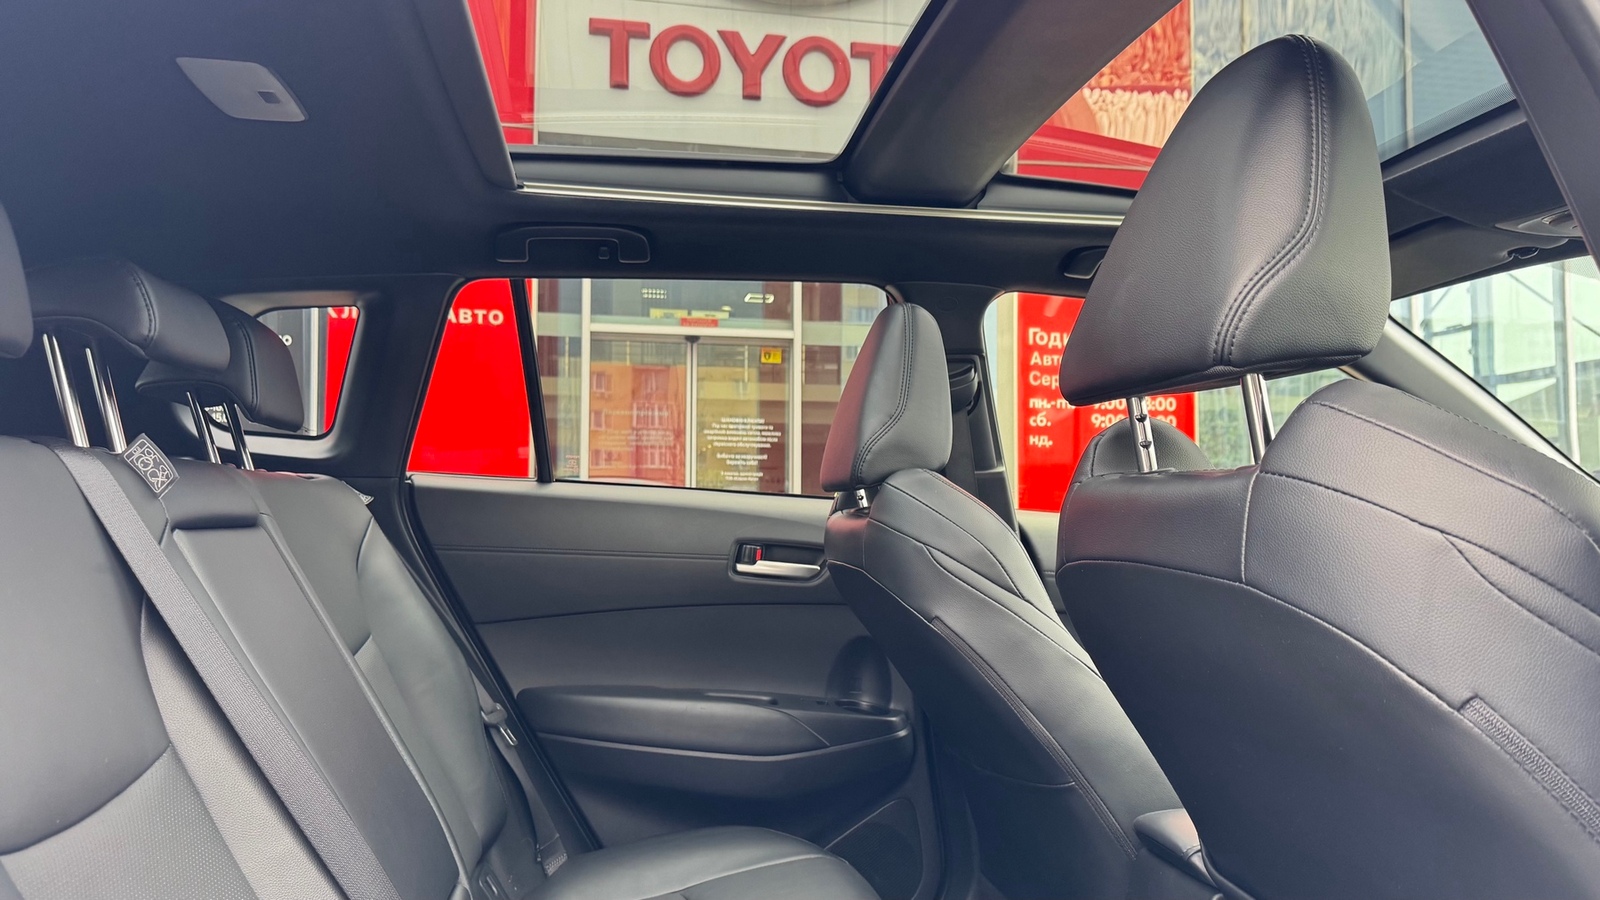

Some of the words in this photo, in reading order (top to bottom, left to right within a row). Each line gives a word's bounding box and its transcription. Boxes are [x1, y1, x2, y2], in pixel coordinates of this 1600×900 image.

[1029, 351, 1062, 366] Авт
[1029, 411, 1051, 427] сб.
[1029, 435, 1053, 448] нд.
